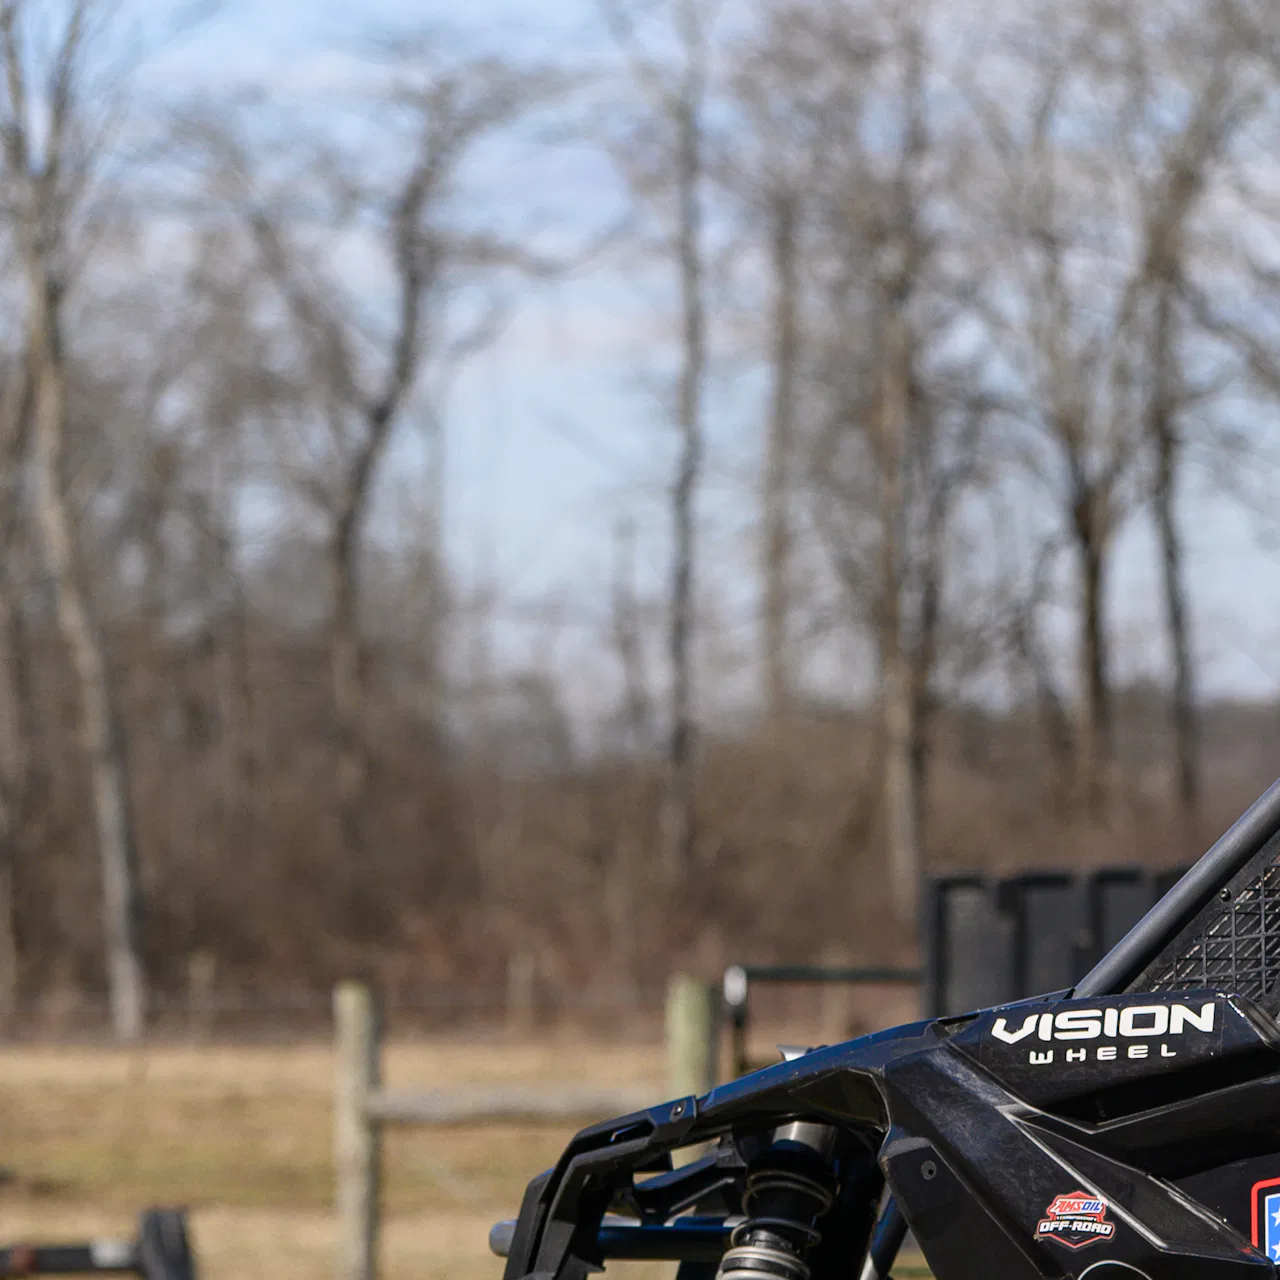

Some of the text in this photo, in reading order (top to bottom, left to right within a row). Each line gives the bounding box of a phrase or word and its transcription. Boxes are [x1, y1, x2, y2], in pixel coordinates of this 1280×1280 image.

[991, 1003, 1215, 1044] VISION
[1029, 1044, 1177, 1065] WHEEL
[1053, 1200, 1102, 1213] AMSOIL
